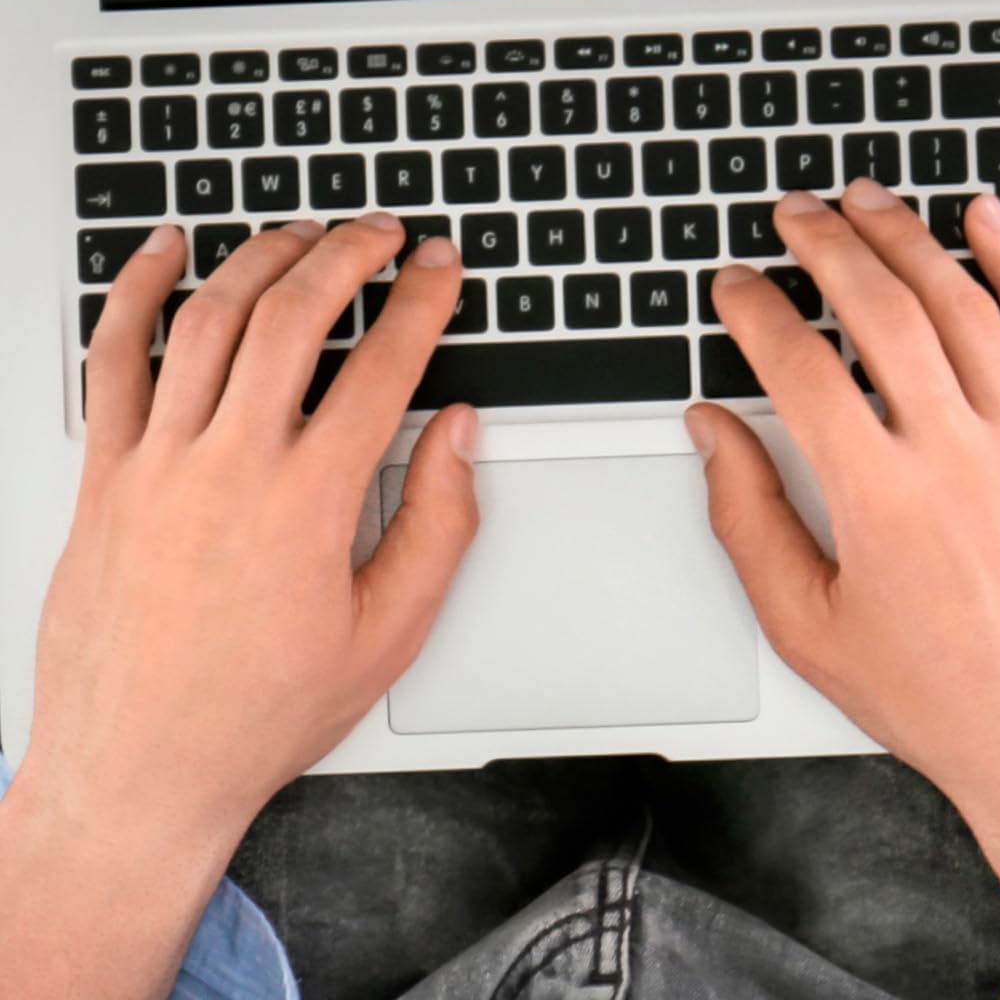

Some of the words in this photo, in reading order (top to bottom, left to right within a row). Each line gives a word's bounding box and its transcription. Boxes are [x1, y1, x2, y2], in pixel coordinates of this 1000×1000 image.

[564, 108, 574, 125] 7
[629, 106, 641, 123] 8
[696, 103, 708, 119] 9
[296, 120, 307, 137] 3
[363, 117, 374, 133] 4
[430, 114, 441, 131] 5
[496, 112, 507, 128] 6
[229, 122, 241, 139] 2
[729, 155, 745, 173] O
[799, 153, 812, 171] P
[398, 169, 409, 186] R
[465, 166, 476, 184] T
[530, 164, 543, 181] Y
[596, 162, 612, 180] U
[195, 178, 212, 195] Q
[261, 174, 280, 192] W
[331, 173, 341, 190] E
[548, 229, 564, 245] H
[619, 227, 628, 244] J
[683, 223, 696, 239] K
[751, 221, 762, 239] L
[481, 231, 497, 249] G
[215, 243, 229, 259] A
[519, 295, 532, 312] B
[585, 293, 600, 309] N
[650, 289, 668, 307] M
